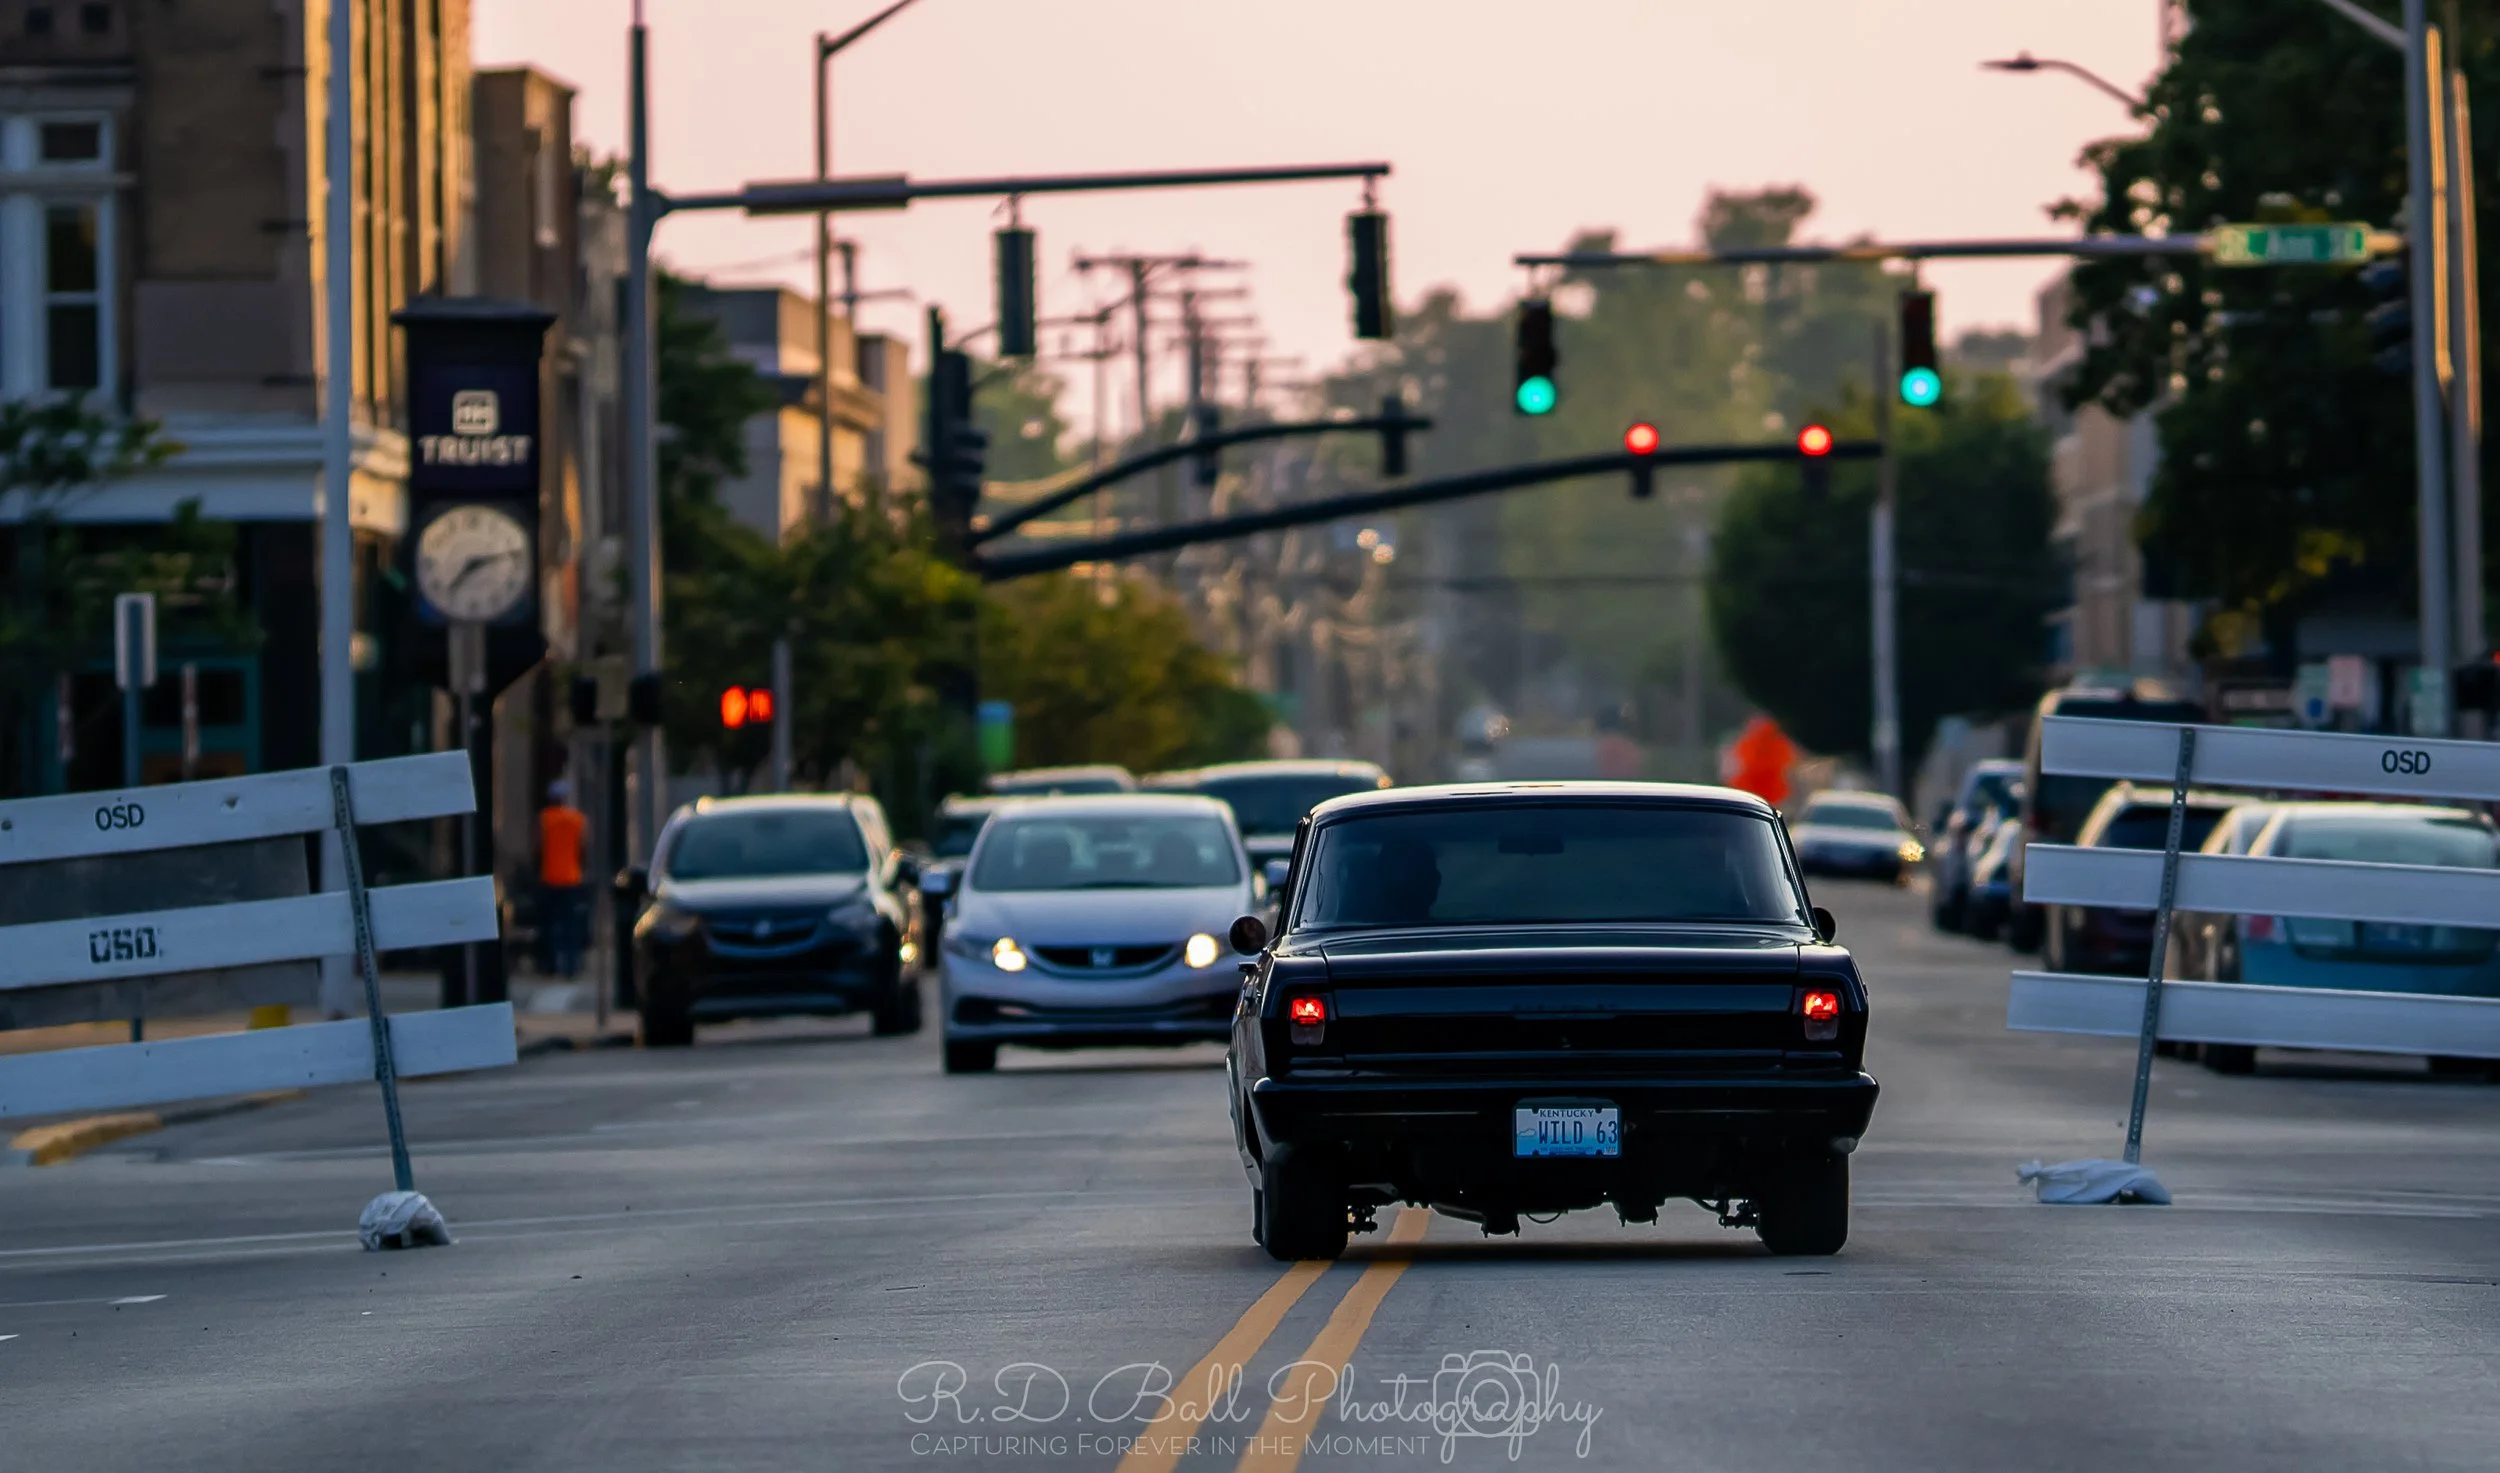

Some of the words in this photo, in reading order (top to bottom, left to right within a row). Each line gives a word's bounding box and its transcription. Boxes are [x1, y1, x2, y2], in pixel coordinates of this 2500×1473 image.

[419, 435, 532, 465] TRUIST
[2382, 749, 2431, 775] OSD
[95, 803, 145, 831] OSD
[1540, 1109, 1594, 1118] KENTUCKY
[1539, 1120, 1583, 1145] WILD
[1596, 1120, 1617, 1144] 63
